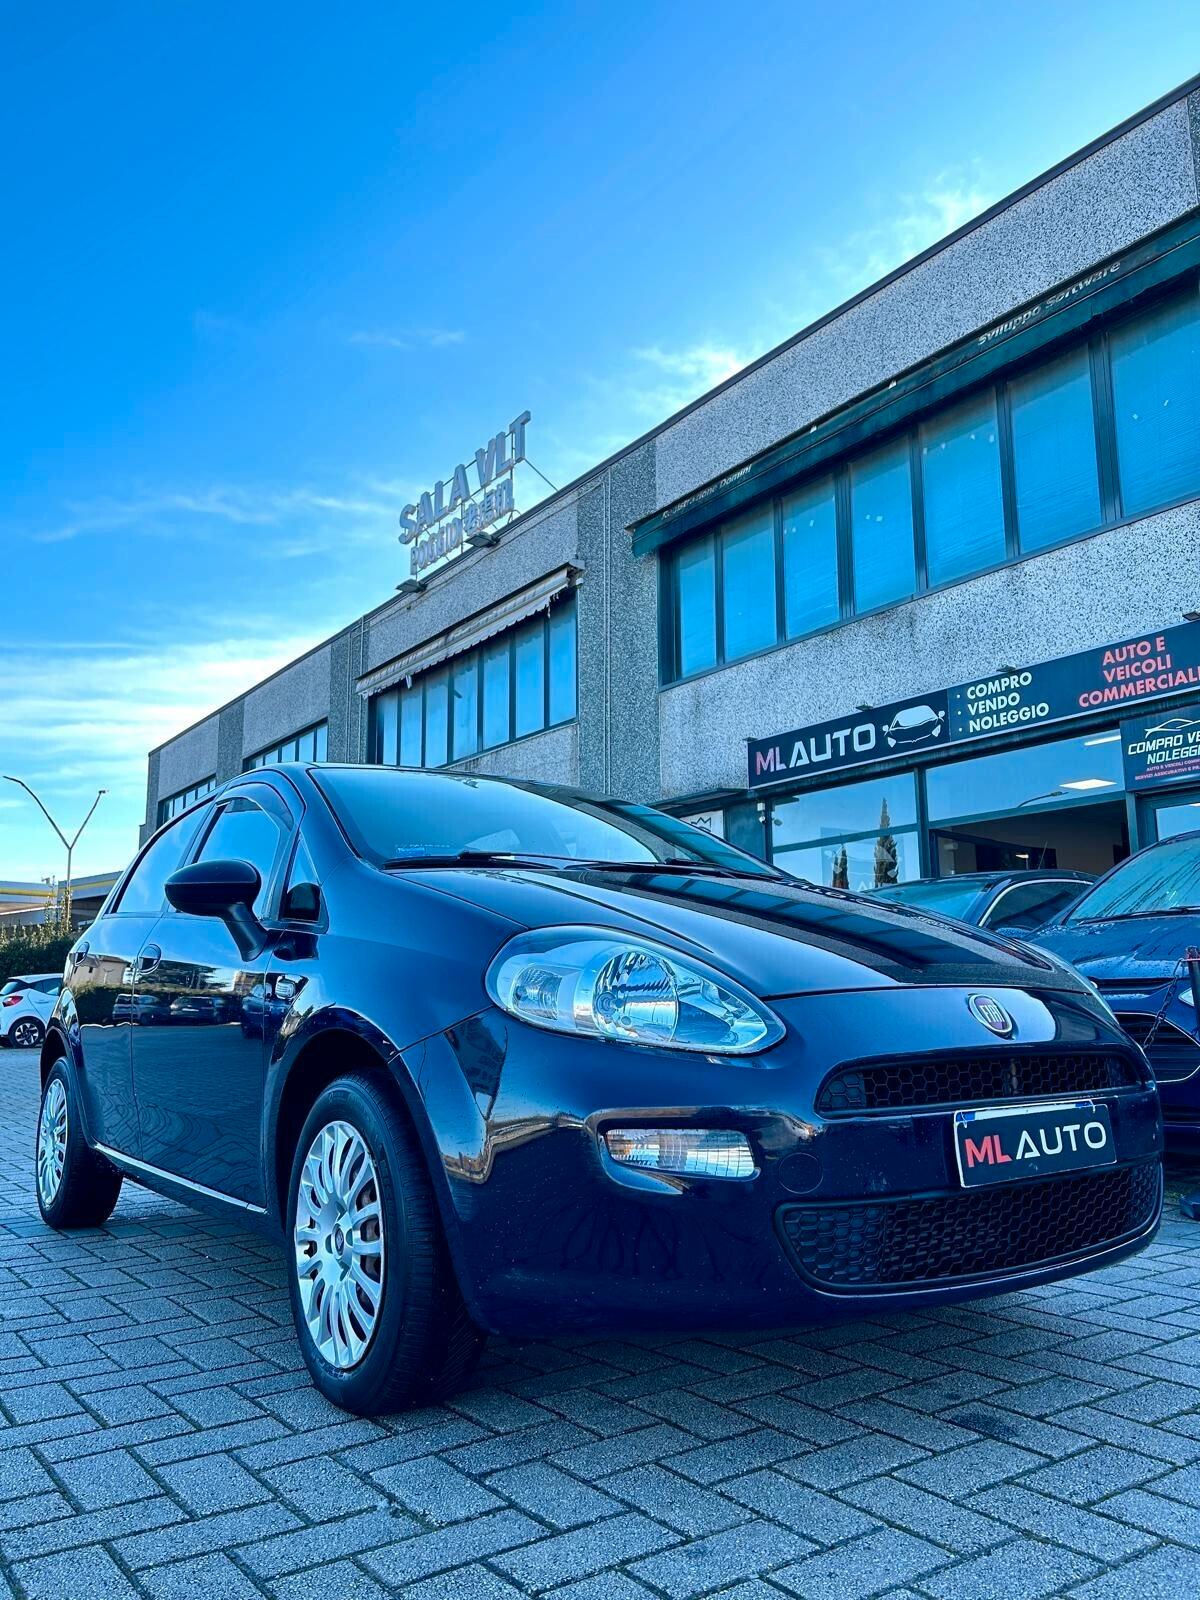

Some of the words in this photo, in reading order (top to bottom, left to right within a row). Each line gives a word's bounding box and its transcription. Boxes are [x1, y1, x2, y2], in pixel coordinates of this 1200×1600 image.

[977, 305, 1042, 346] Sviluppo
[399, 463, 471, 545] SALA
[475, 410, 531, 488] VLT
[1102, 640, 1152, 666] AUTO
[1155, 636, 1166, 652] E
[1102, 654, 1172, 683] VEICOLI
[967, 671, 1032, 700] COMPRO
[967, 692, 1020, 716] VENDO
[968, 702, 1050, 733] NOLEGGIO
[755, 745, 788, 776] ML
[789, 722, 876, 769] AUTO
[1128, 734, 1183, 755] COMPRO
[979, 1004, 1005, 1023] FIAT
[964, 1134, 1013, 1168] ML
[1015, 1121, 1107, 1160] AUTO
